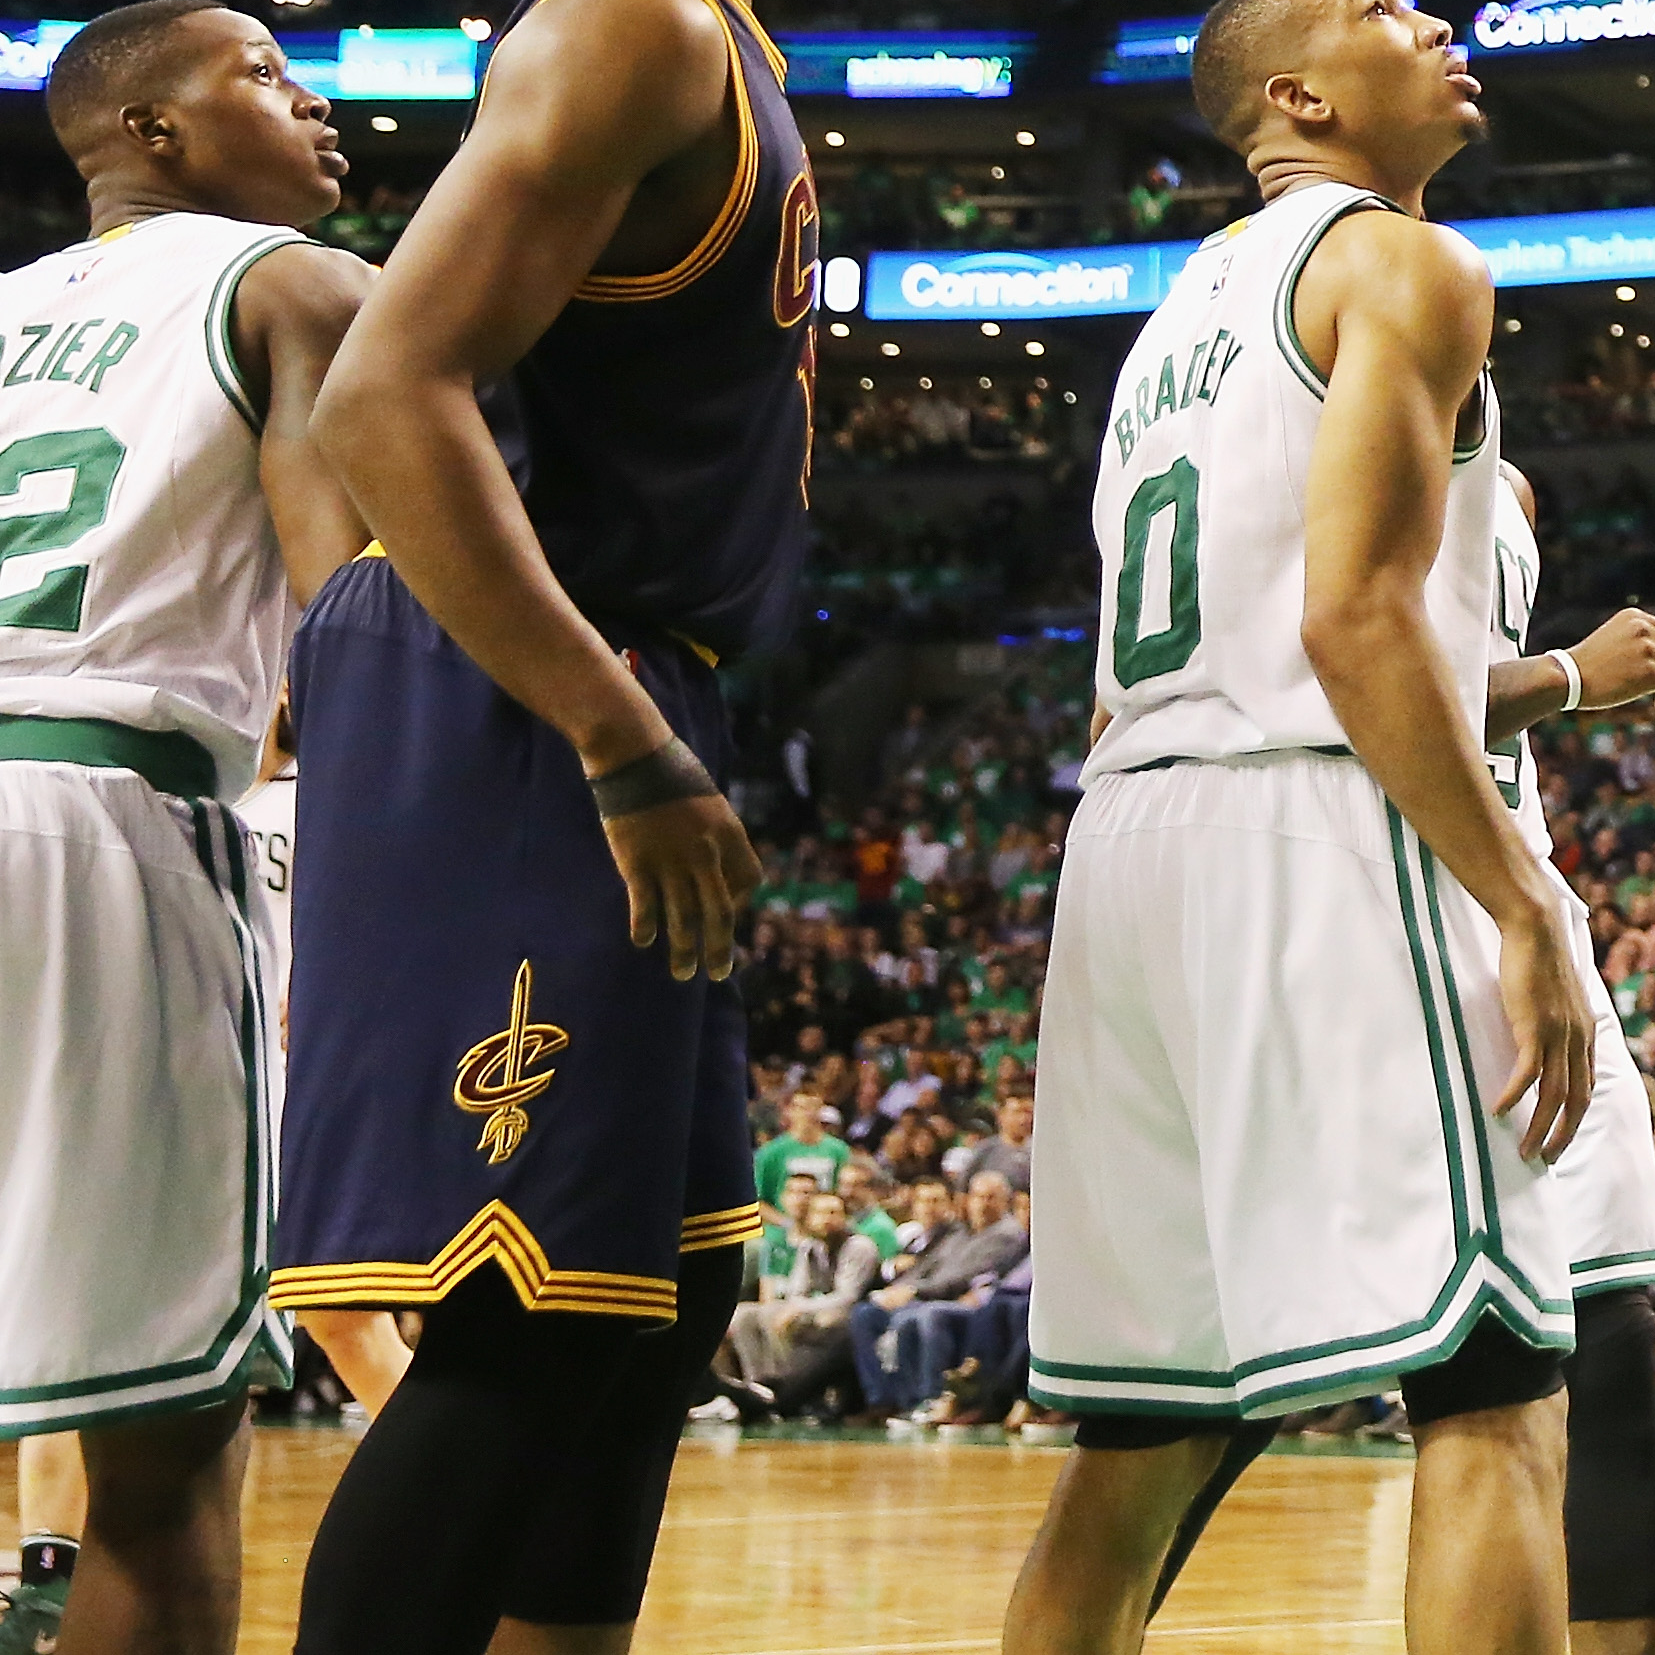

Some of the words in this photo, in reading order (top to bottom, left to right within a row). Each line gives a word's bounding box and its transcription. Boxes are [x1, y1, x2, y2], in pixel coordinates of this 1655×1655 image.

[901, 260, 1132, 309] Connection
[0, 318, 140, 393] ZIER
[0, 425, 127, 633] 2
[1113, 454, 1201, 691] 0
